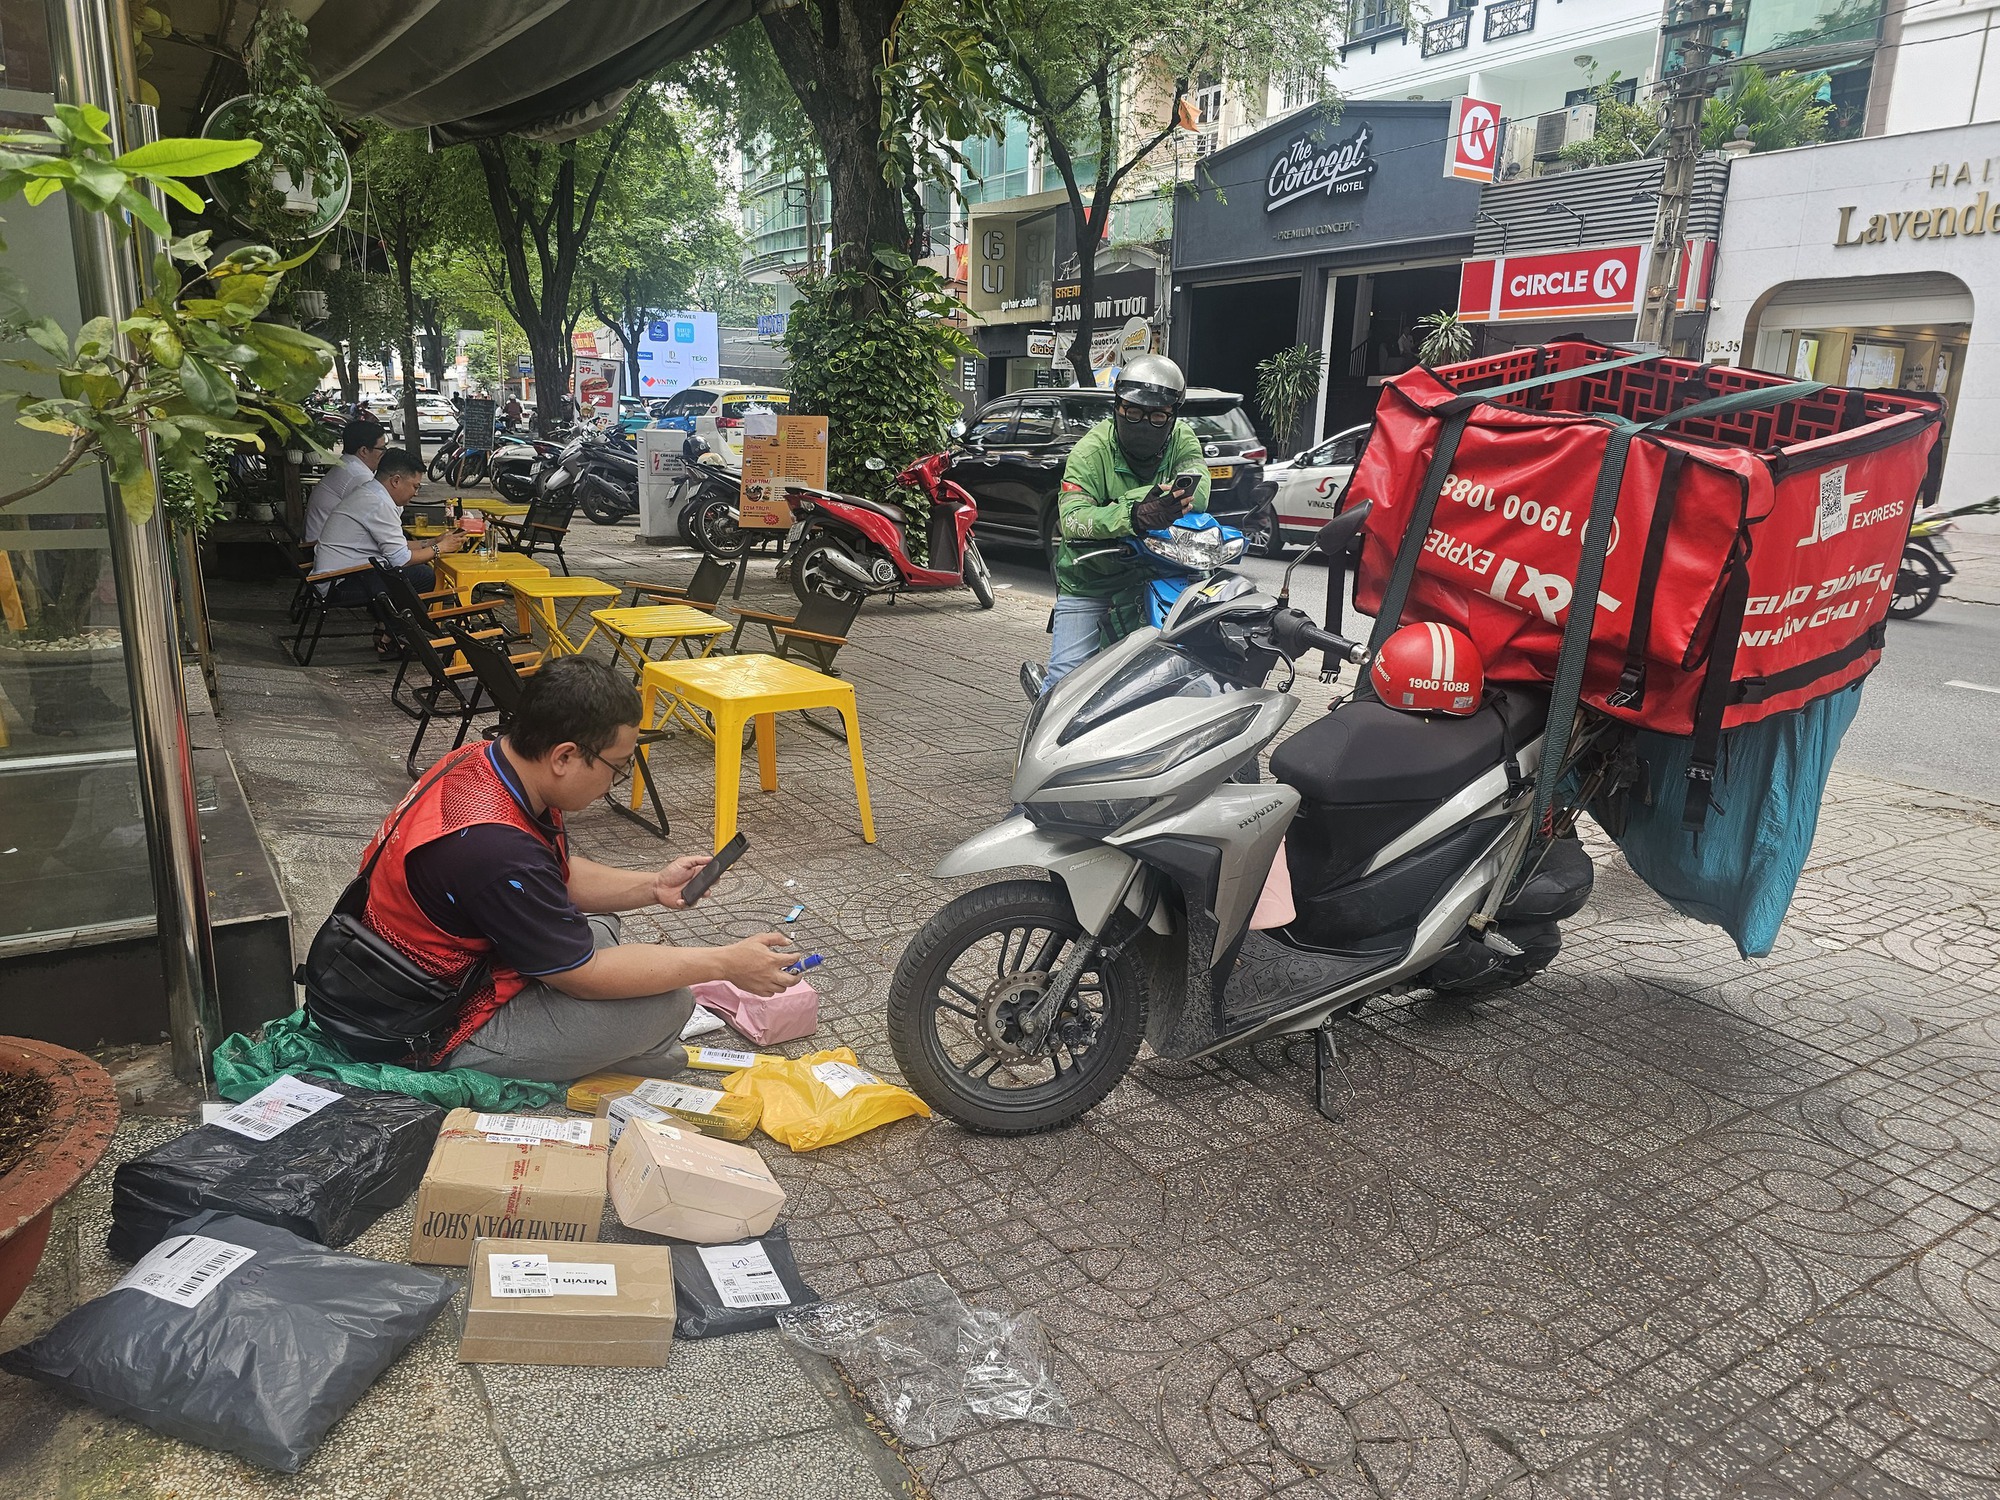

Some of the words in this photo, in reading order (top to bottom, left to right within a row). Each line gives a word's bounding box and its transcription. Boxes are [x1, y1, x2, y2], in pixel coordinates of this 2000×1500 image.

[1469, 117, 1491, 147] K
[1268, 128, 1367, 196] Concept
[1290, 138, 1312, 164] The
[1336, 181, 1364, 193] HOTEL
[1930, 158, 1992, 188] HAI
[1277, 226, 1314, 240] PREMIUM
[1314, 221, 1355, 235] CONCEPT
[1510, 270, 1588, 297] CIRCLE
[1600, 267, 1622, 290] K
[1054, 301, 1081, 322] BÁN
[1094, 296, 1112, 319] MÌ
[579, 366, 591, 374] 39
[656, 378, 678, 386] VNPAY
[1307, 500, 1334, 509] VINASU
[1439, 473, 1496, 512] 1088
[1503, 494, 1572, 537] 1900
[1852, 500, 1904, 530] EXPRESS
[1412, 527, 1496, 575] EXPRE
[1815, 563, 1885, 600] ĐÚNG
[1408, 677, 1439, 691] 1900
[1442, 681, 1470, 693] 1088
[1237, 799, 1284, 830] HONDA
[614, 1127, 625, 1136] 12
[423, 1210, 471, 1241] SHOP
[563, 1277, 607, 1286] Marvin
